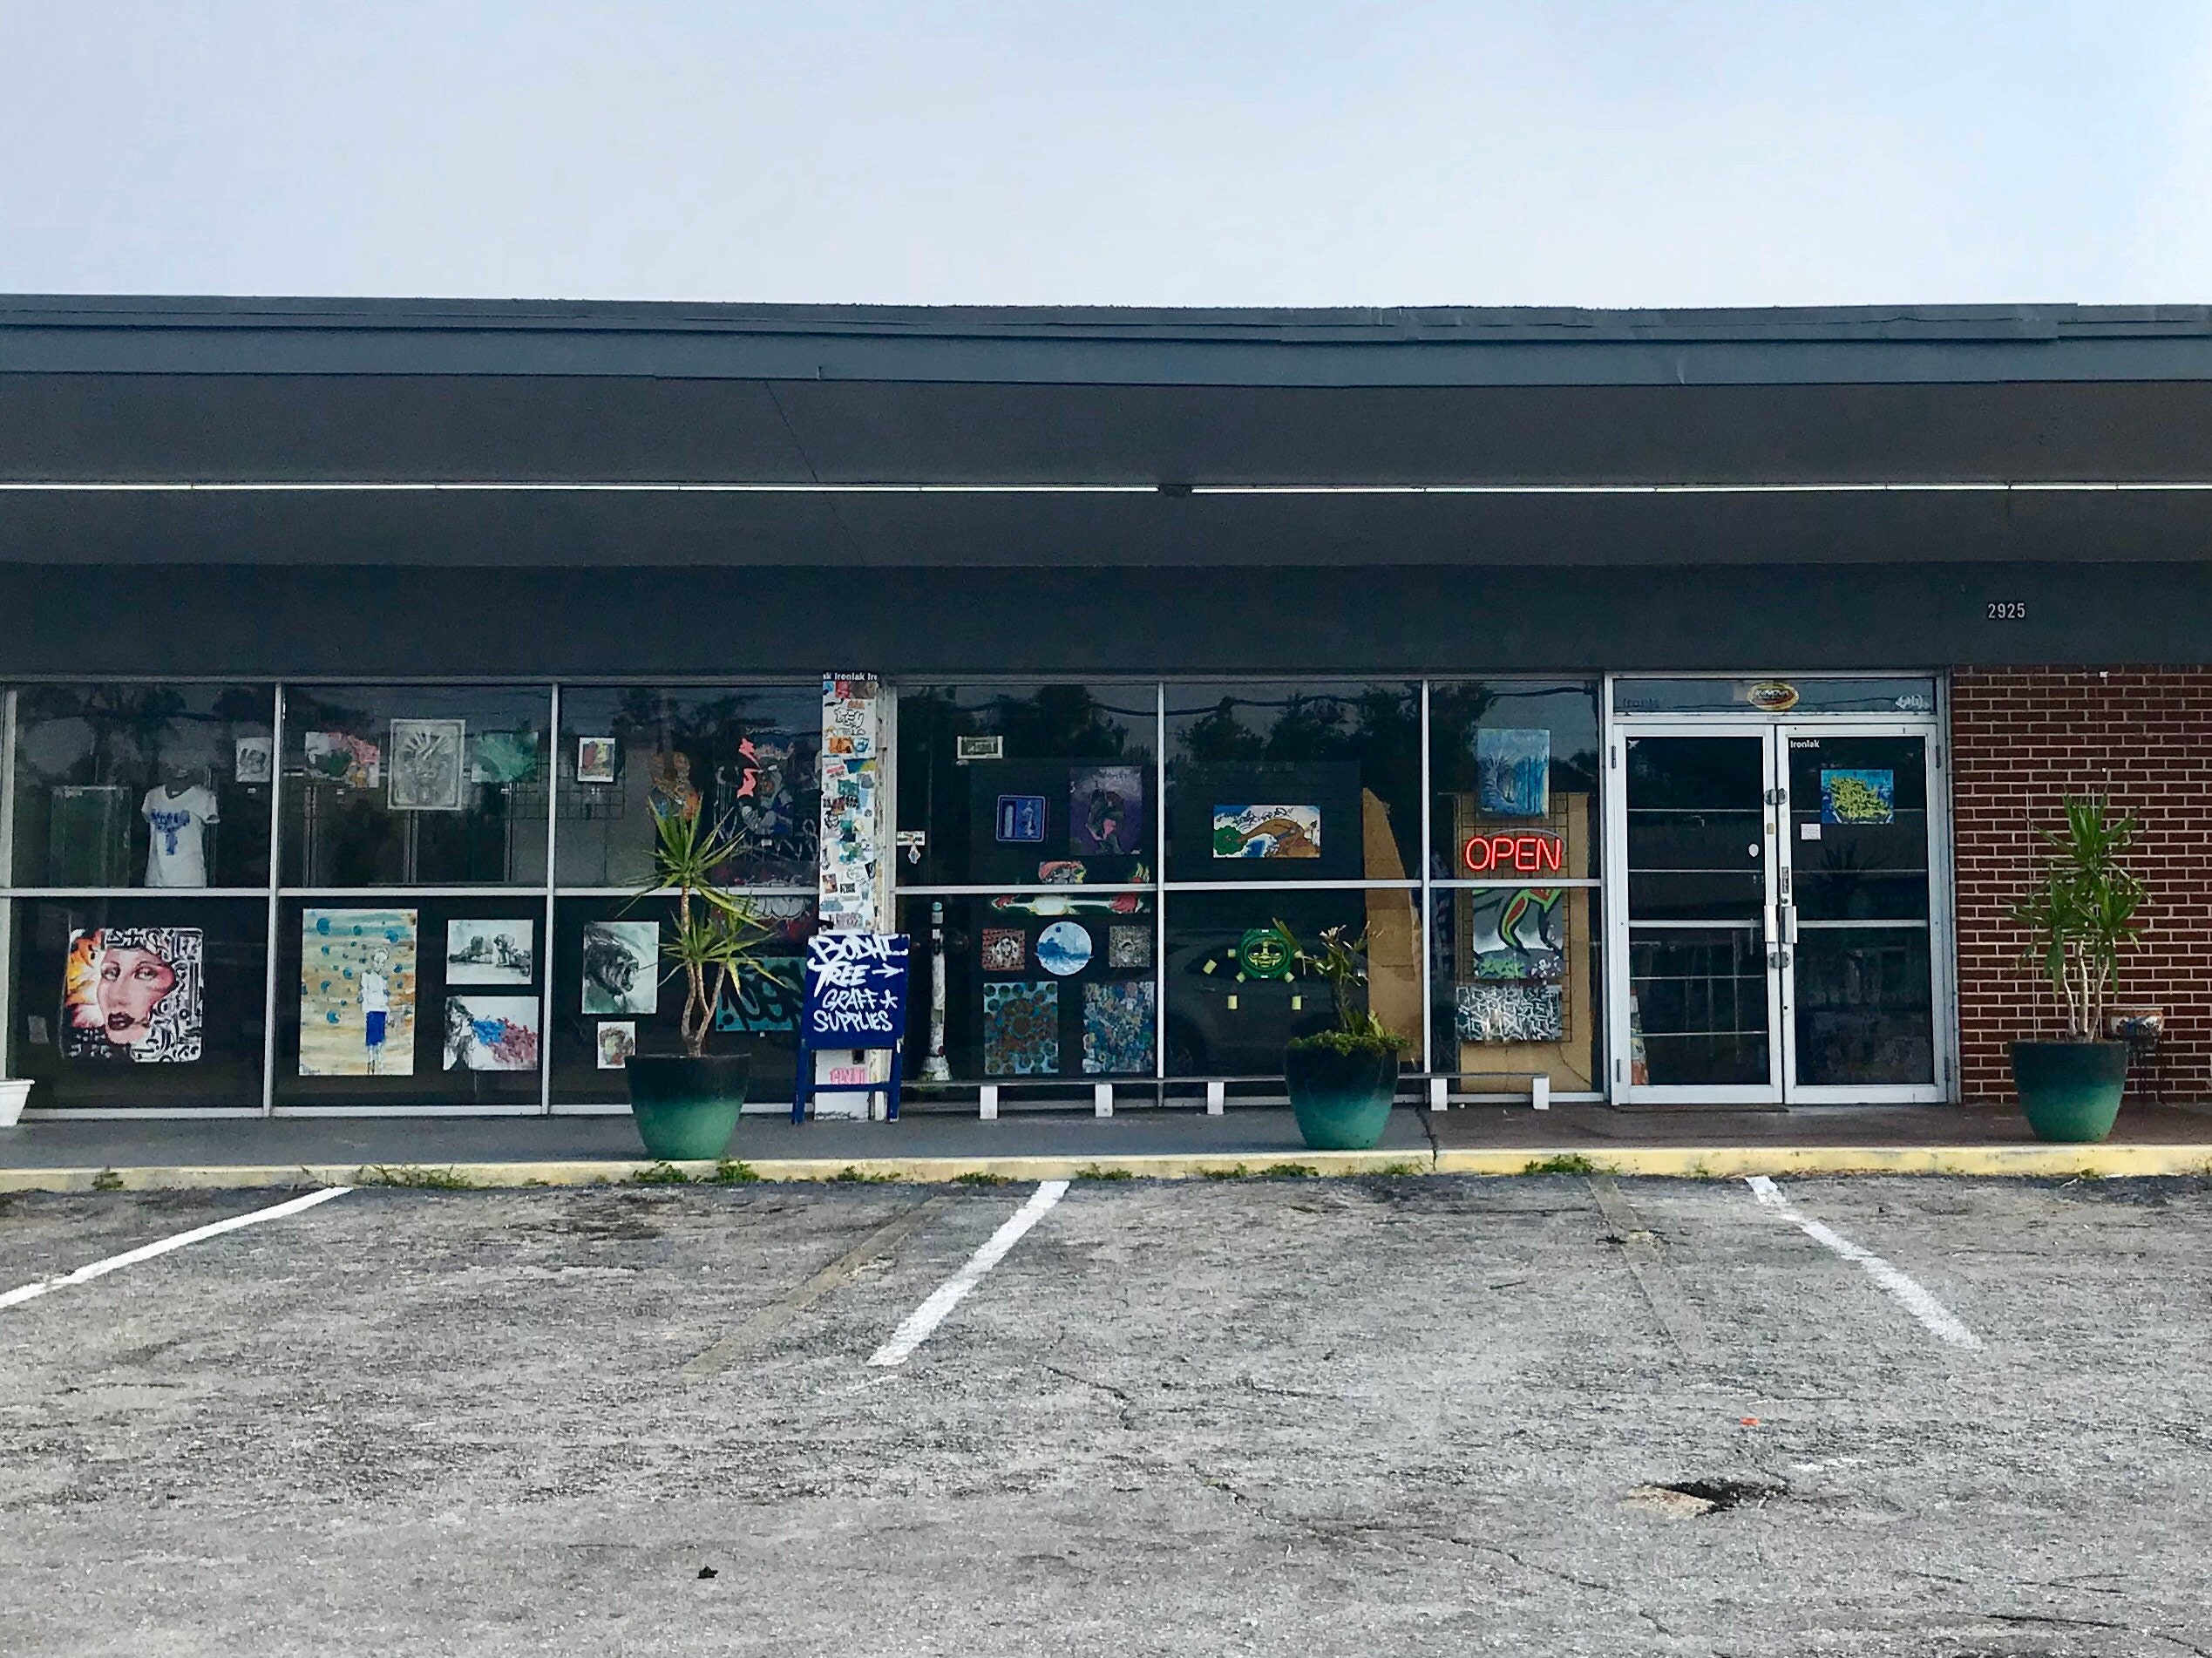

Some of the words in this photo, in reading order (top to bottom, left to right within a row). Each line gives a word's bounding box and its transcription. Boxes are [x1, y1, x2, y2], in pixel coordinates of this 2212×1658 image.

[1988, 602, 2025, 619] 2925
[1790, 739, 1820, 749] Ironlak
[1464, 837, 1562, 871] OPEN
[808, 933, 909, 964] BODHI
[806, 957, 871, 998] TREE
[822, 987, 879, 1011] GRAFF
[813, 1009, 893, 1032] SUPPLIES
